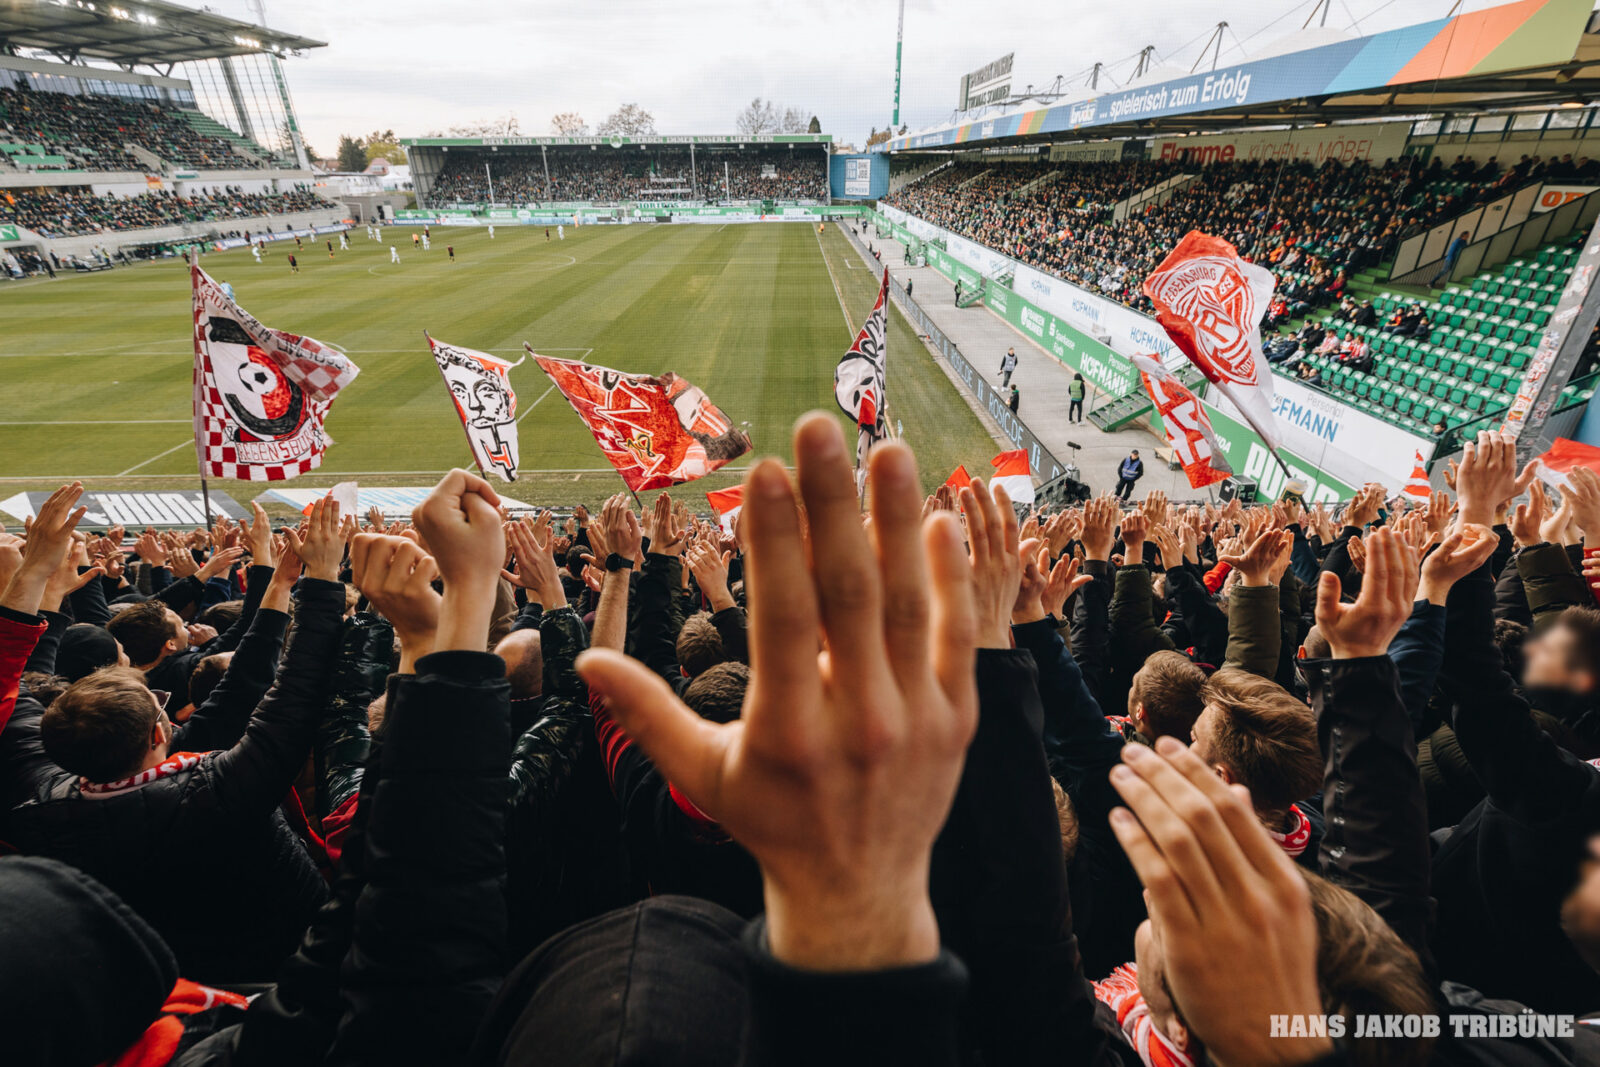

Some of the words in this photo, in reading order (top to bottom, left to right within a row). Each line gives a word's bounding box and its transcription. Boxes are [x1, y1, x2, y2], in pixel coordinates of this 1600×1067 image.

[1109, 91, 1166, 121] spielerisch
[1168, 85, 1198, 107] zum
[1201, 70, 1251, 104] Erfolg
[1247, 140, 1299, 161] KÜCHEN
[1314, 136, 1374, 163] MÖBEL
[1162, 266, 1217, 305] REGENSBURG
[1072, 298, 1099, 321] HOFMANN
[1130, 326, 1171, 358] HOFMANN
[1079, 351, 1129, 398] HOFMANN
[989, 391, 1024, 450] ROSIC.DE
